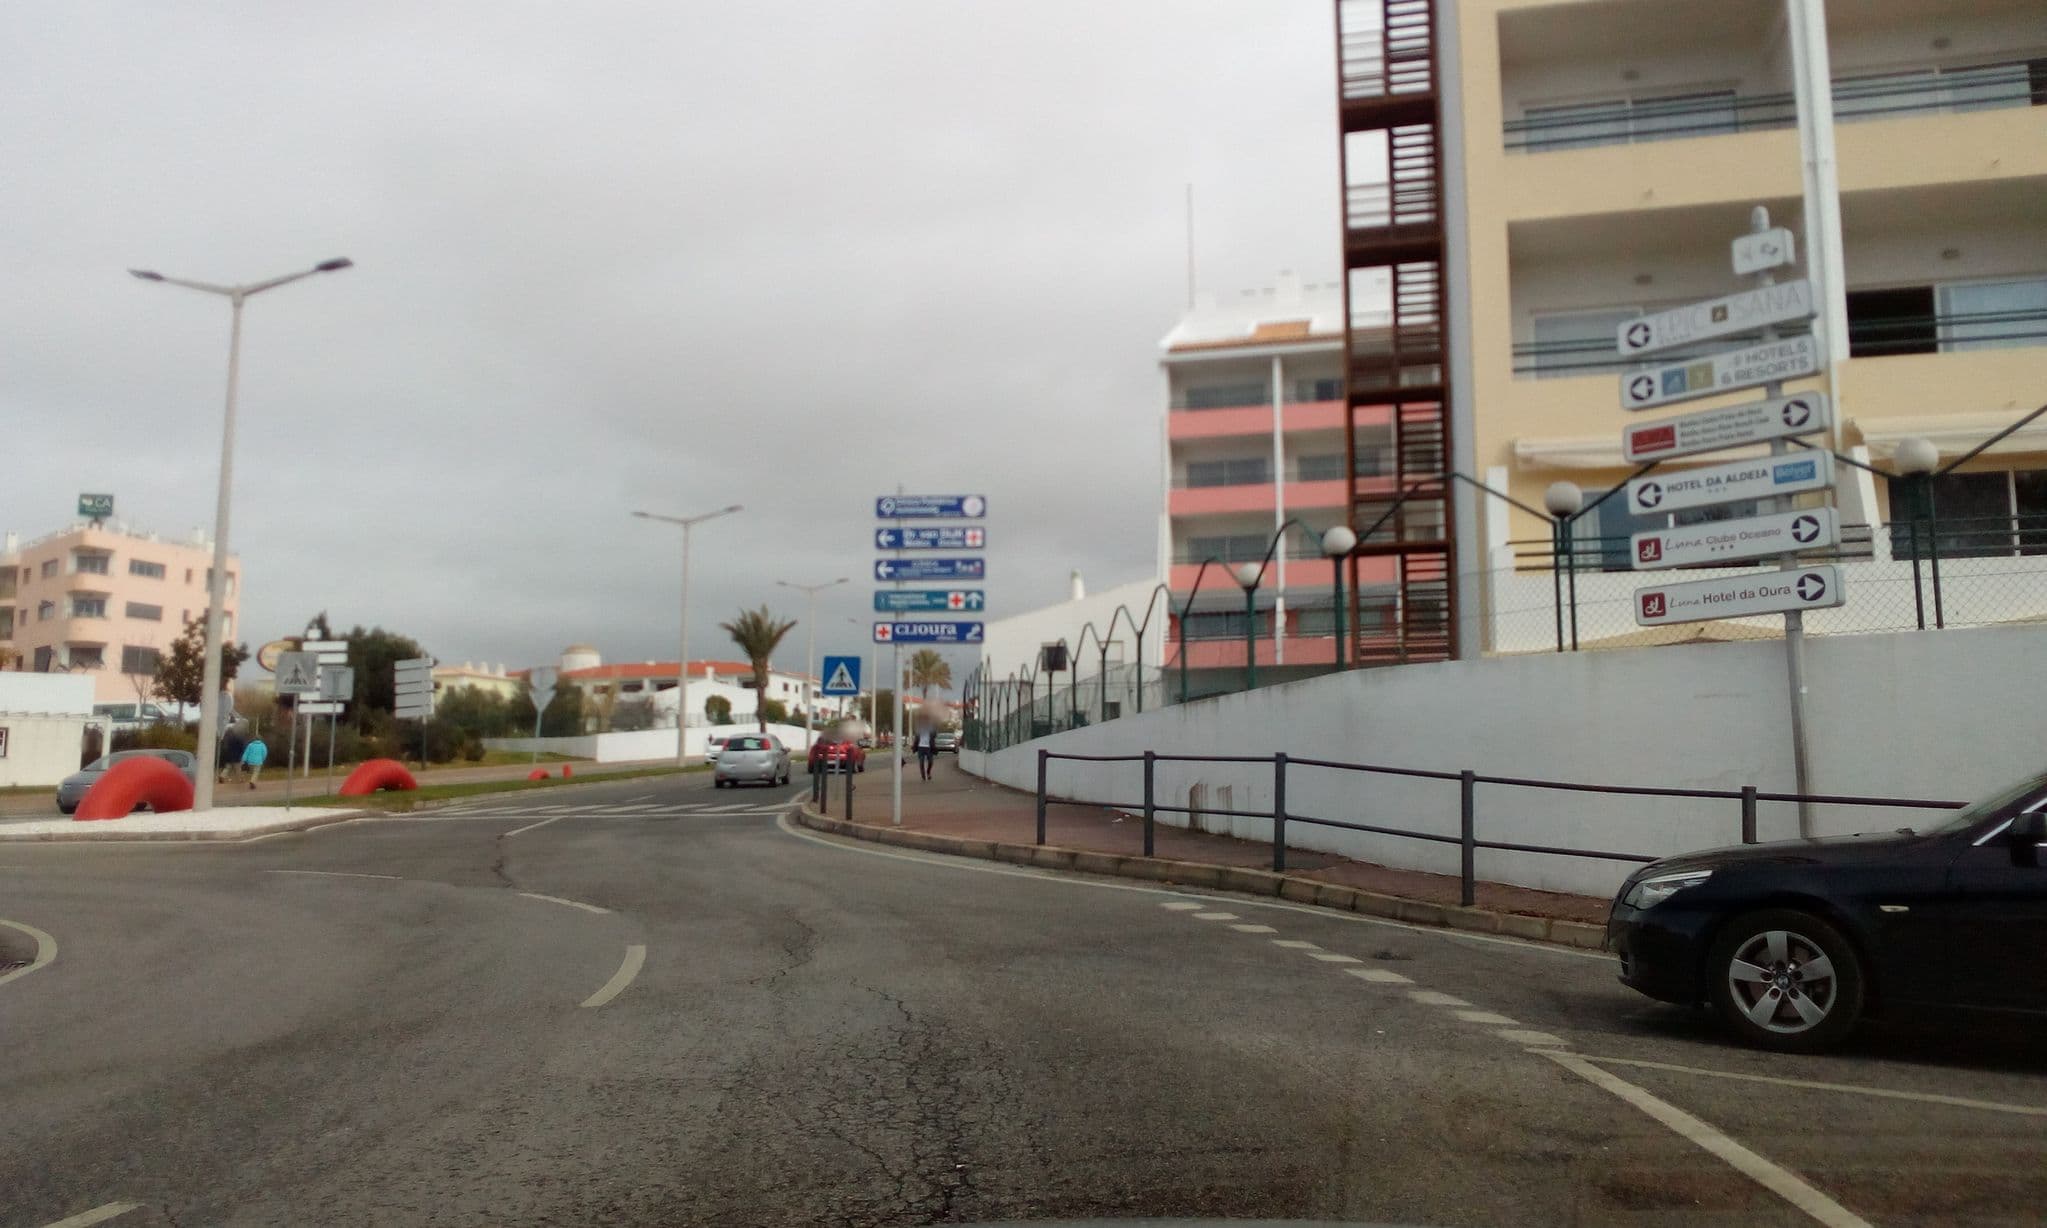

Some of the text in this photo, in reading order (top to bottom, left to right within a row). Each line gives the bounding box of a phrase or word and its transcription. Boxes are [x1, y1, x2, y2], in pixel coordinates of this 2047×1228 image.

[1734, 357, 1809, 382] RESORTS
[1666, 479, 1703, 494] HOTEL
[1705, 474, 1723, 487] DA
[1725, 468, 1769, 485] ALDEIA
[1738, 527, 1782, 541] Oceano
[1669, 584, 1792, 609] Luna Hotel da Oura
